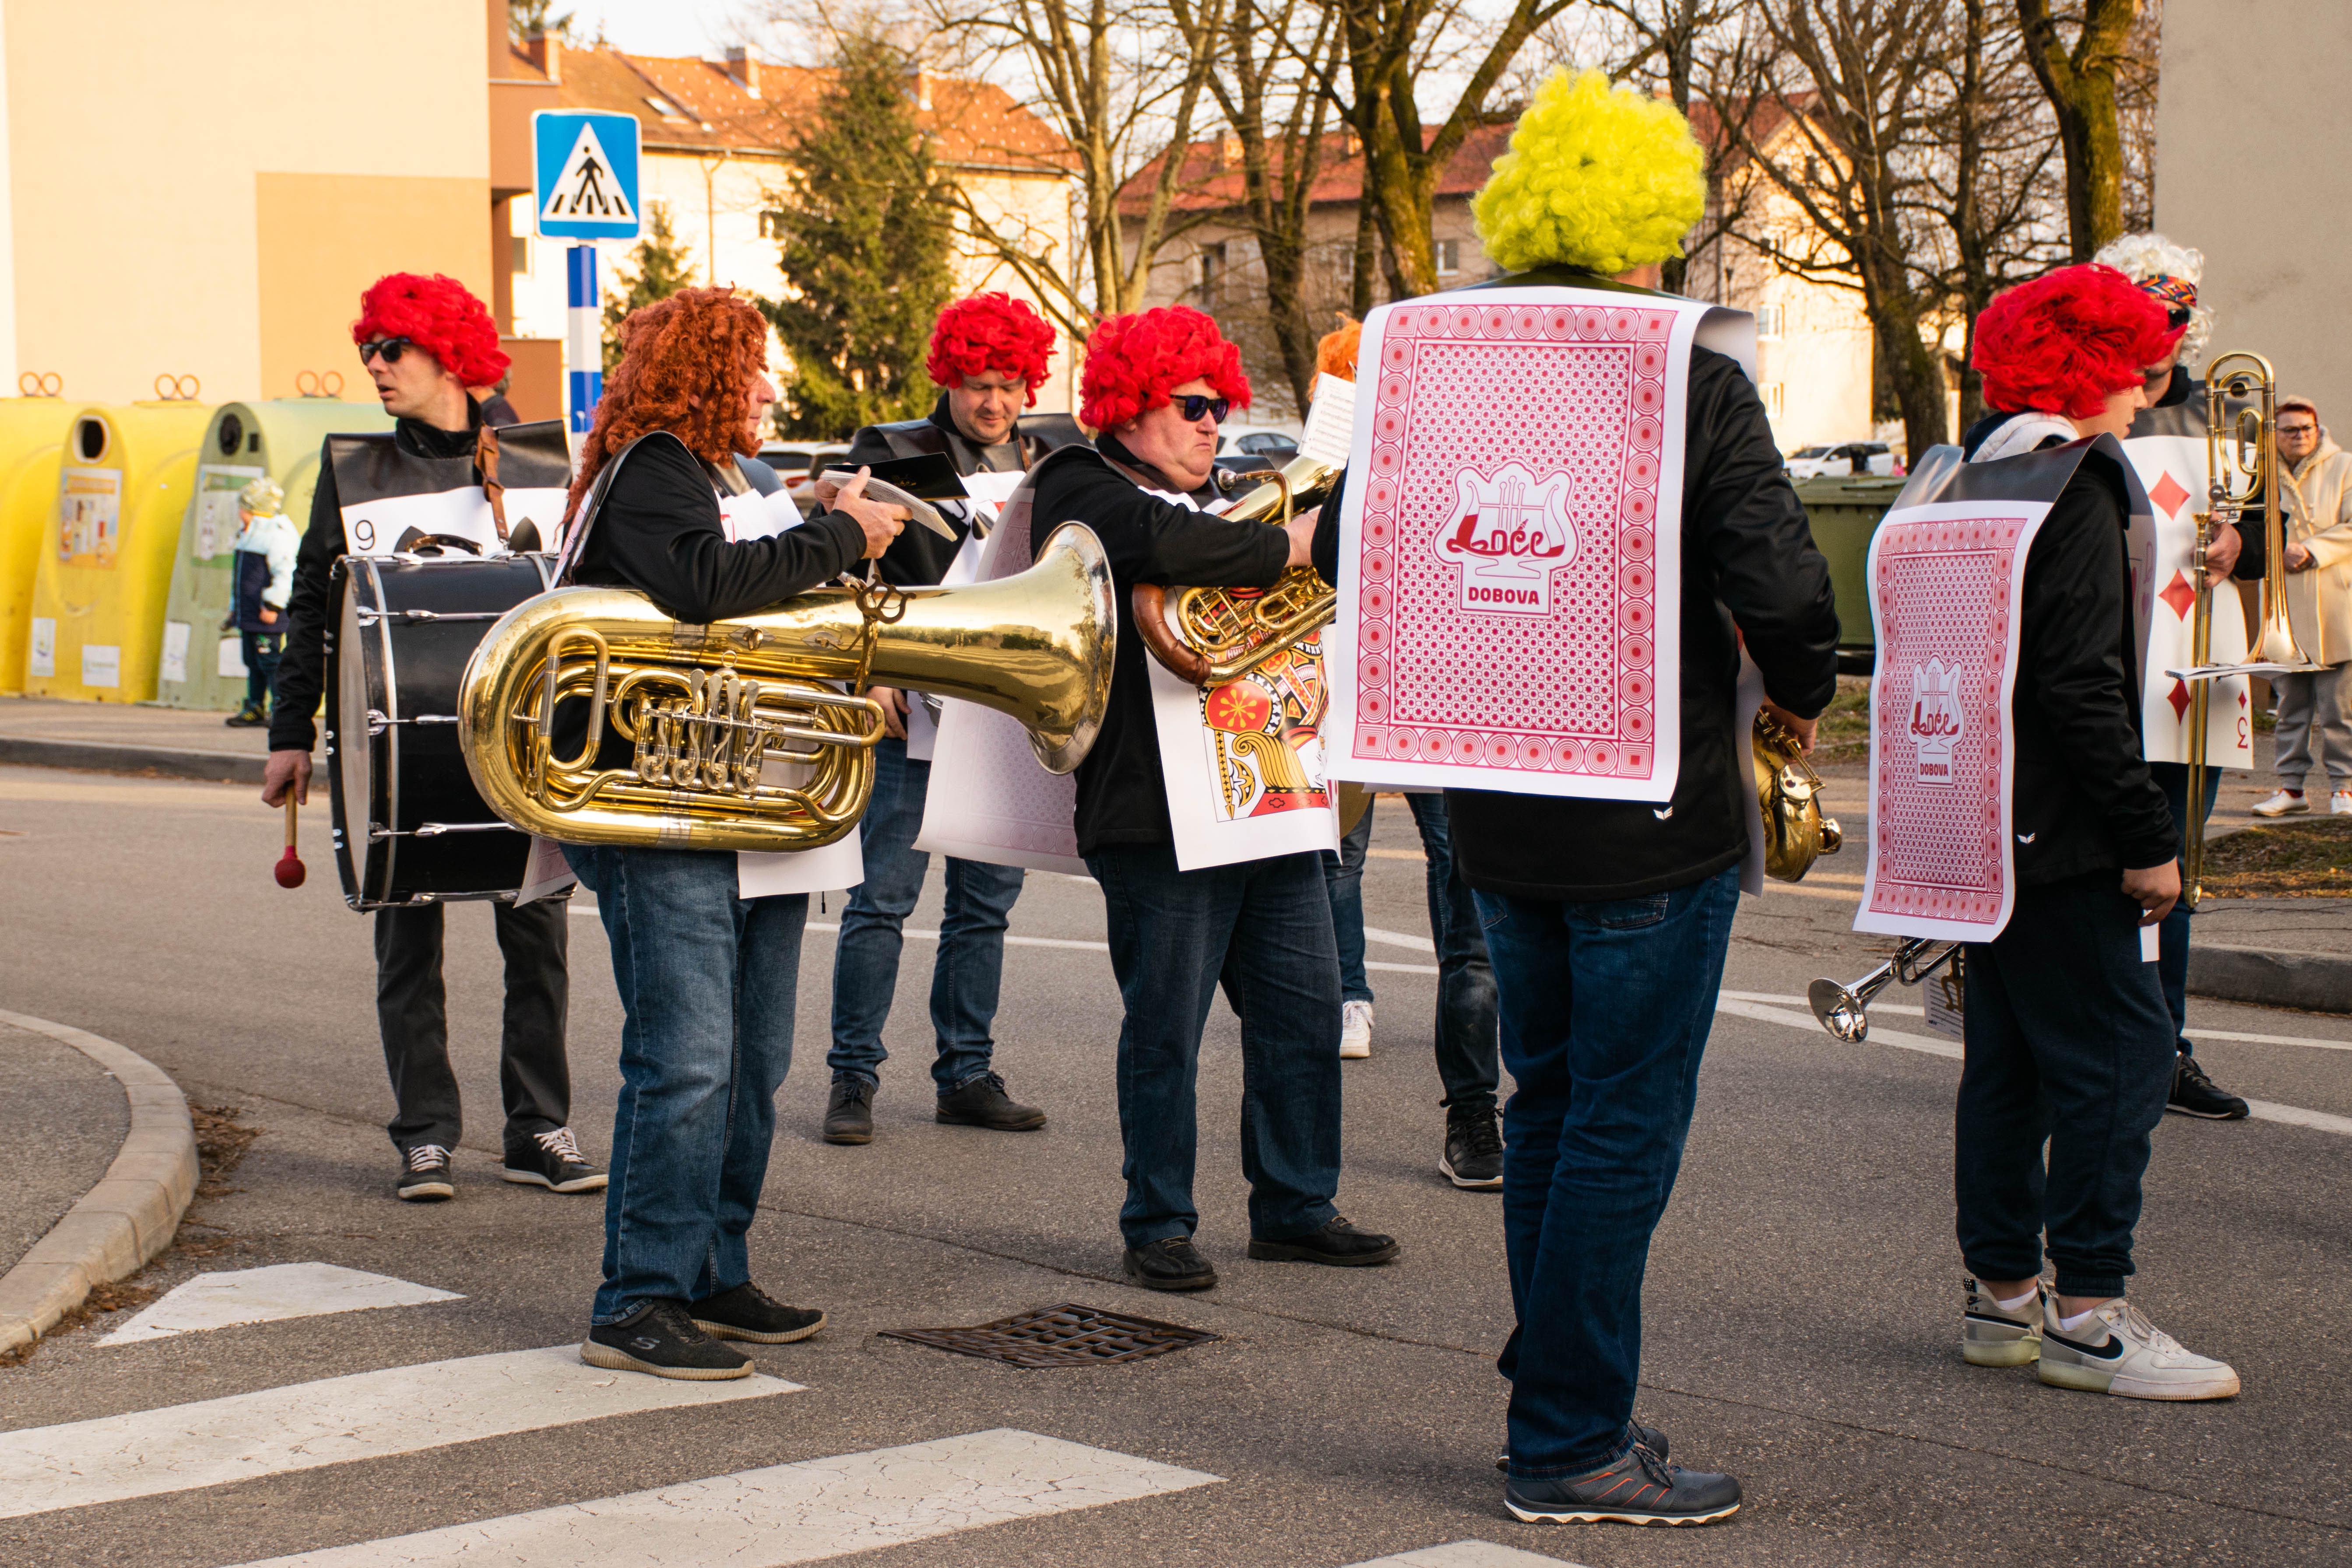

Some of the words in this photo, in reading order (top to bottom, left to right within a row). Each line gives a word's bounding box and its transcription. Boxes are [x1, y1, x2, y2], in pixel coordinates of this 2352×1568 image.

[355, 520, 375, 550] 9
[1468, 587, 1540, 605] DOBOVA
[2237, 716, 2248, 749] 3
[1920, 763, 1948, 777] DOBOVA
